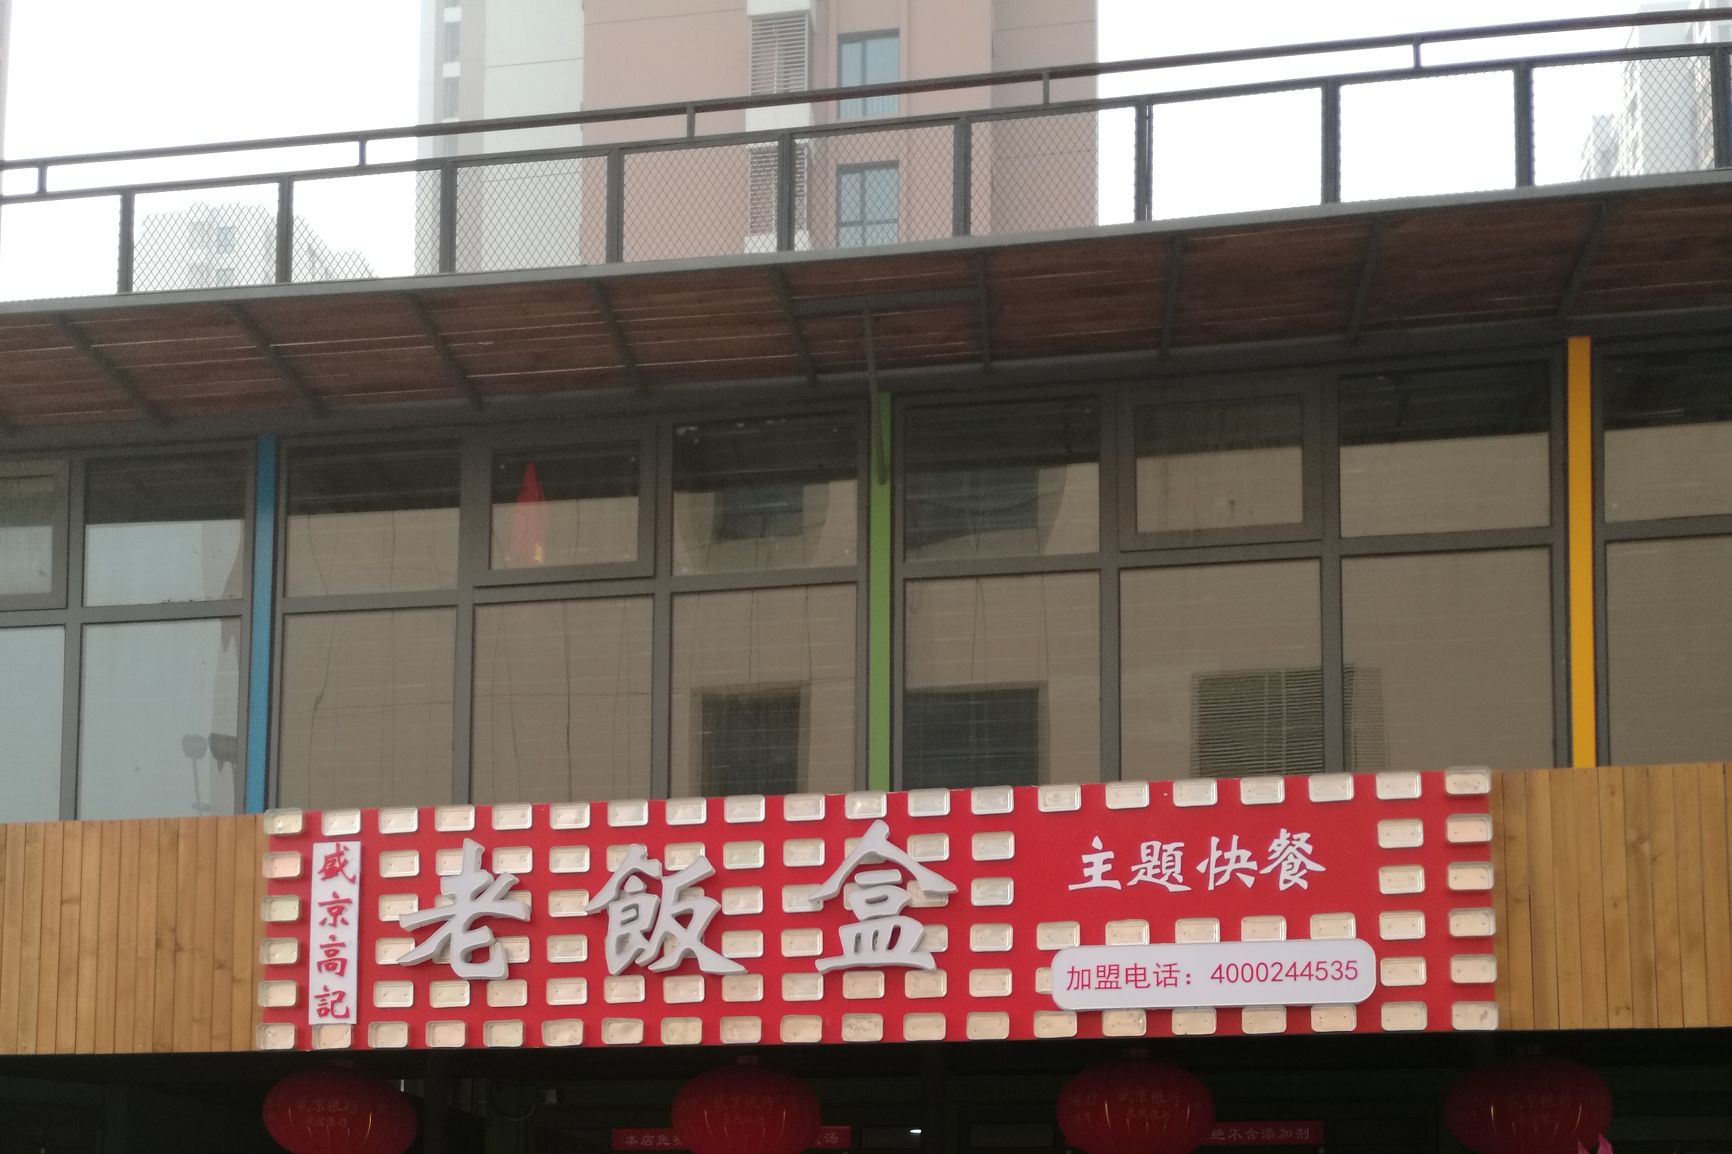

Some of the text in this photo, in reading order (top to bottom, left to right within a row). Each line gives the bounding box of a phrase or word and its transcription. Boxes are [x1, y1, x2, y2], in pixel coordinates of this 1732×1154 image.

[397, 818, 959, 981] 老飯盒
[1067, 828, 1326, 893] 主題快餐
